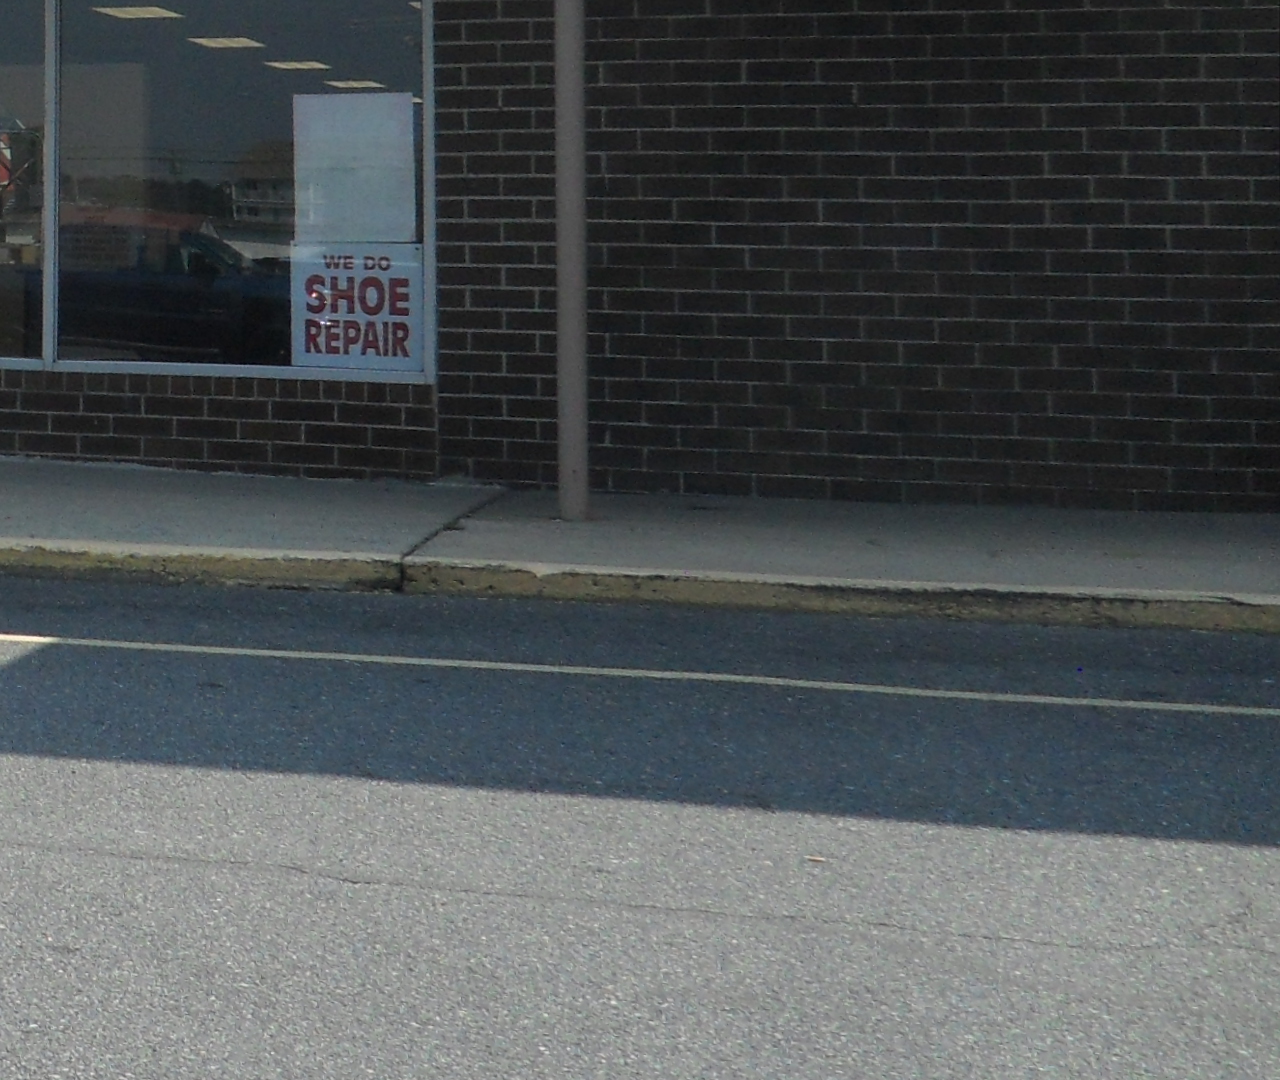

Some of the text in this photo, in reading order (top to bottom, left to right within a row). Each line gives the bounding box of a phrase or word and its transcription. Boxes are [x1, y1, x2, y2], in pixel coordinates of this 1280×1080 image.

[322, 254, 391, 271] WE DO
[305, 274, 410, 316] SHOE
[304, 319, 411, 358] REPAIR
